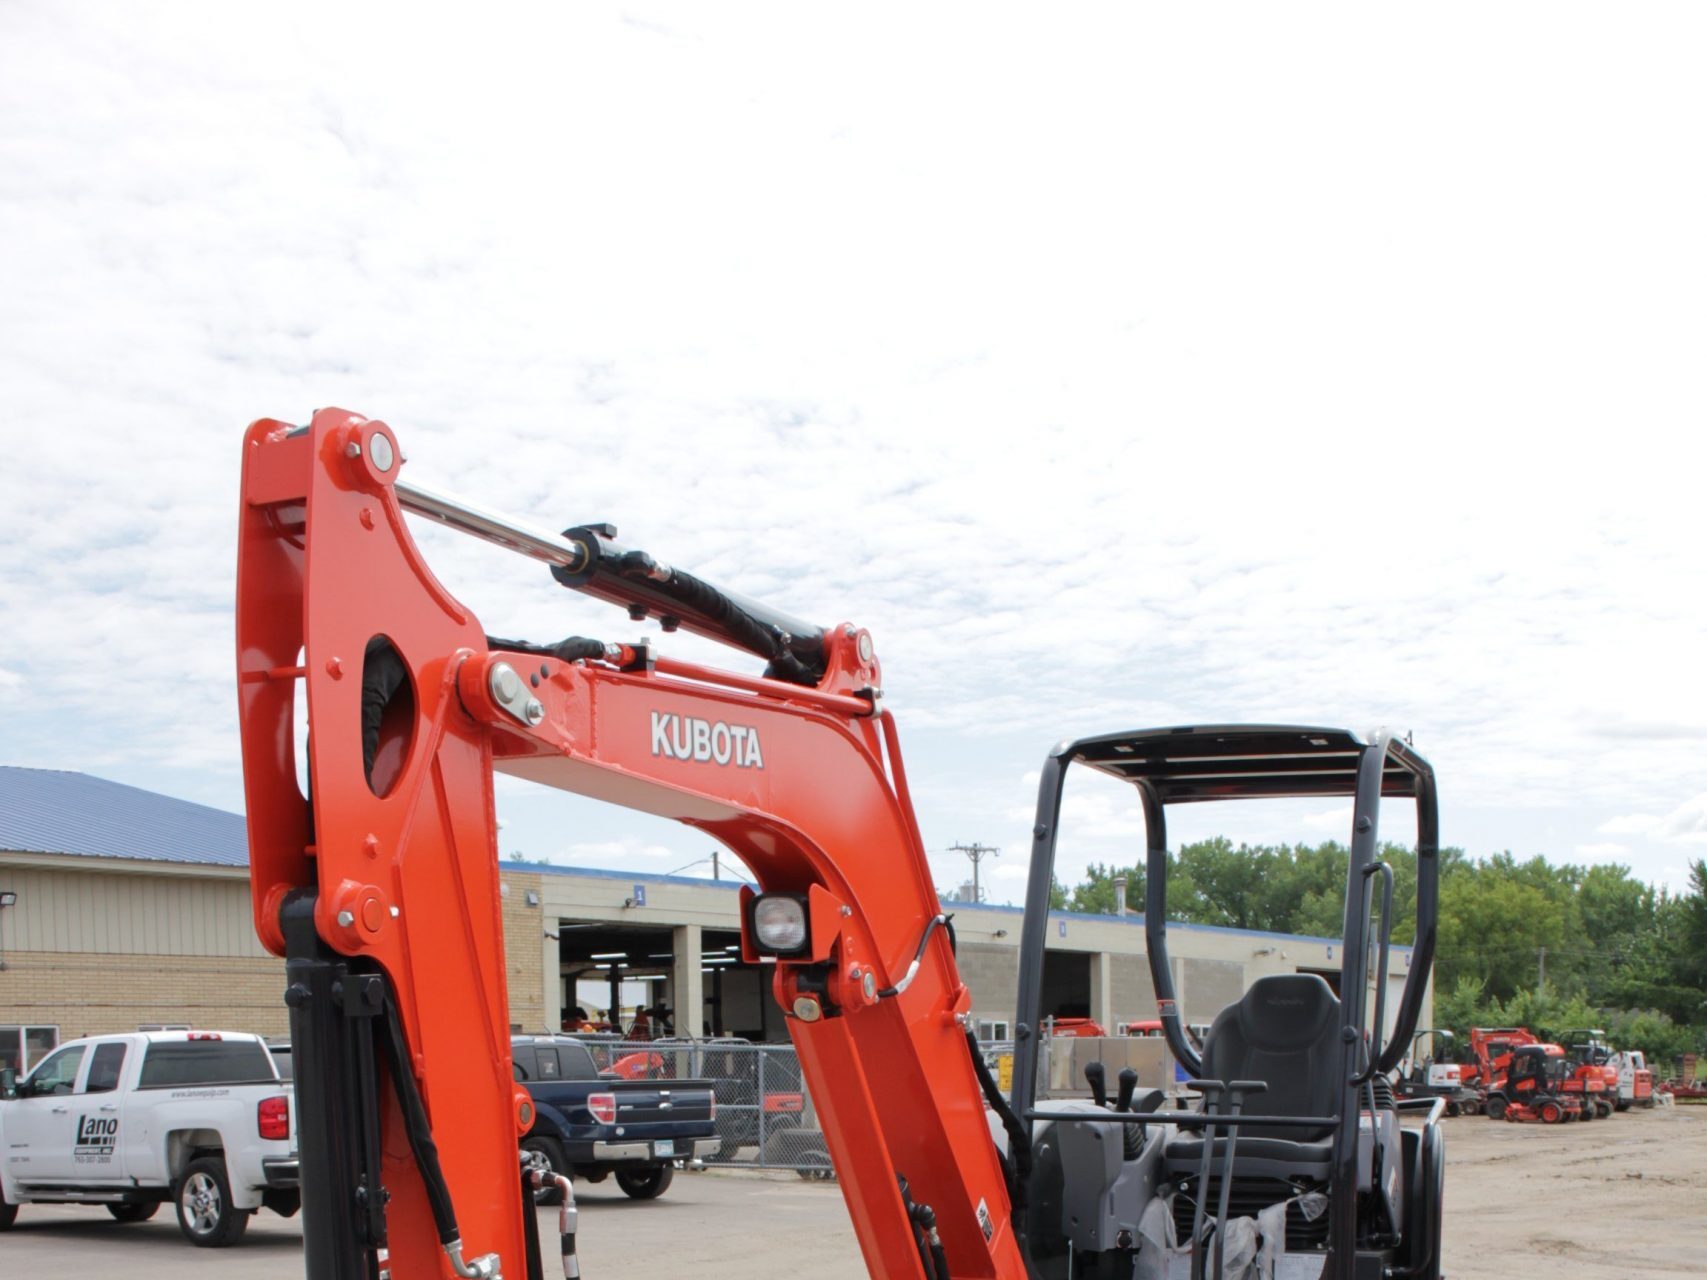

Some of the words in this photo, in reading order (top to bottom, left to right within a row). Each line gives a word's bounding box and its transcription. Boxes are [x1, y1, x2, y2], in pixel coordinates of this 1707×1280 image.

[651, 711, 764, 769] KUBOTA
[637, 890, 643, 901] 1
[77, 1114, 118, 1145] Lano
